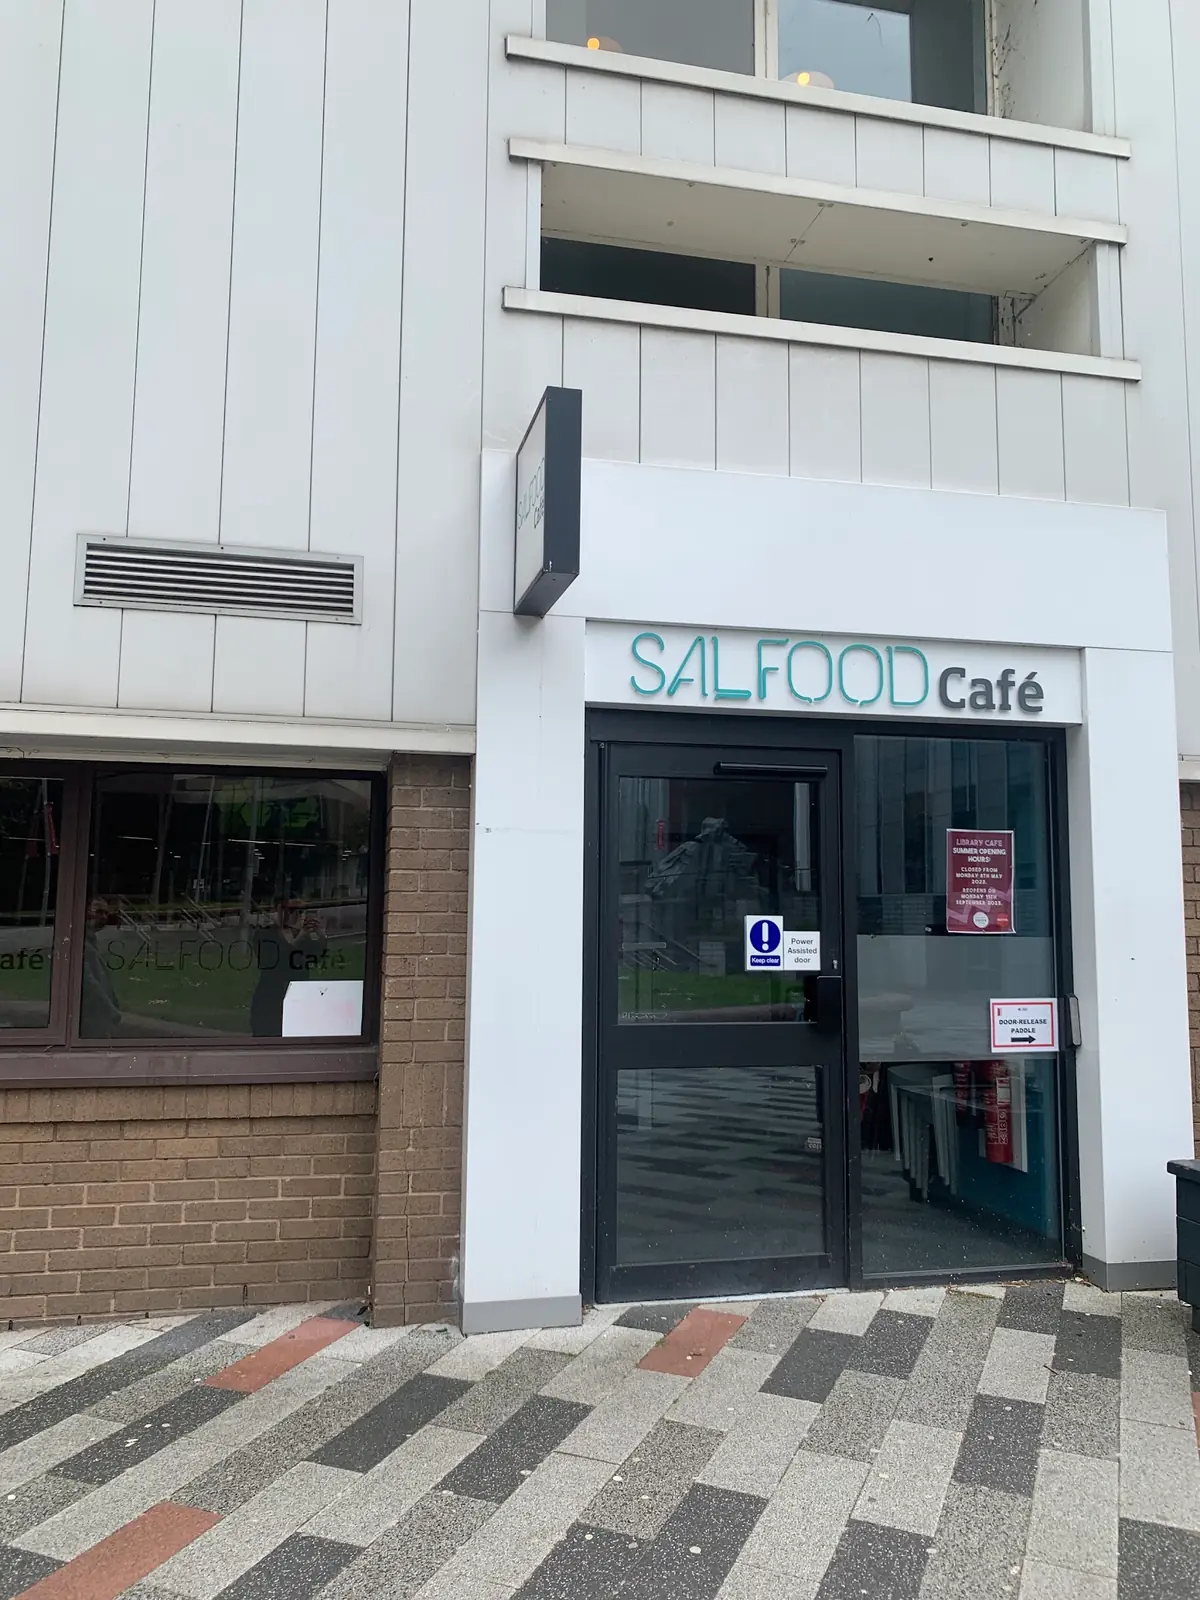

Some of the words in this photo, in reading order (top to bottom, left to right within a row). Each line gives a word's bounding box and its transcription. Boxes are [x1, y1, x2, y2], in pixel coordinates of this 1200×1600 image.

[631, 632, 929, 707] SALFOOD
[938, 667, 1044, 712] Café
[953, 847, 979, 855] SUMMER
[956, 838, 983, 846] LIBRARY
[0, 947, 44, 970] afé
[106, 940, 280, 971] SALFOOD
[289, 948, 346, 971] Café
